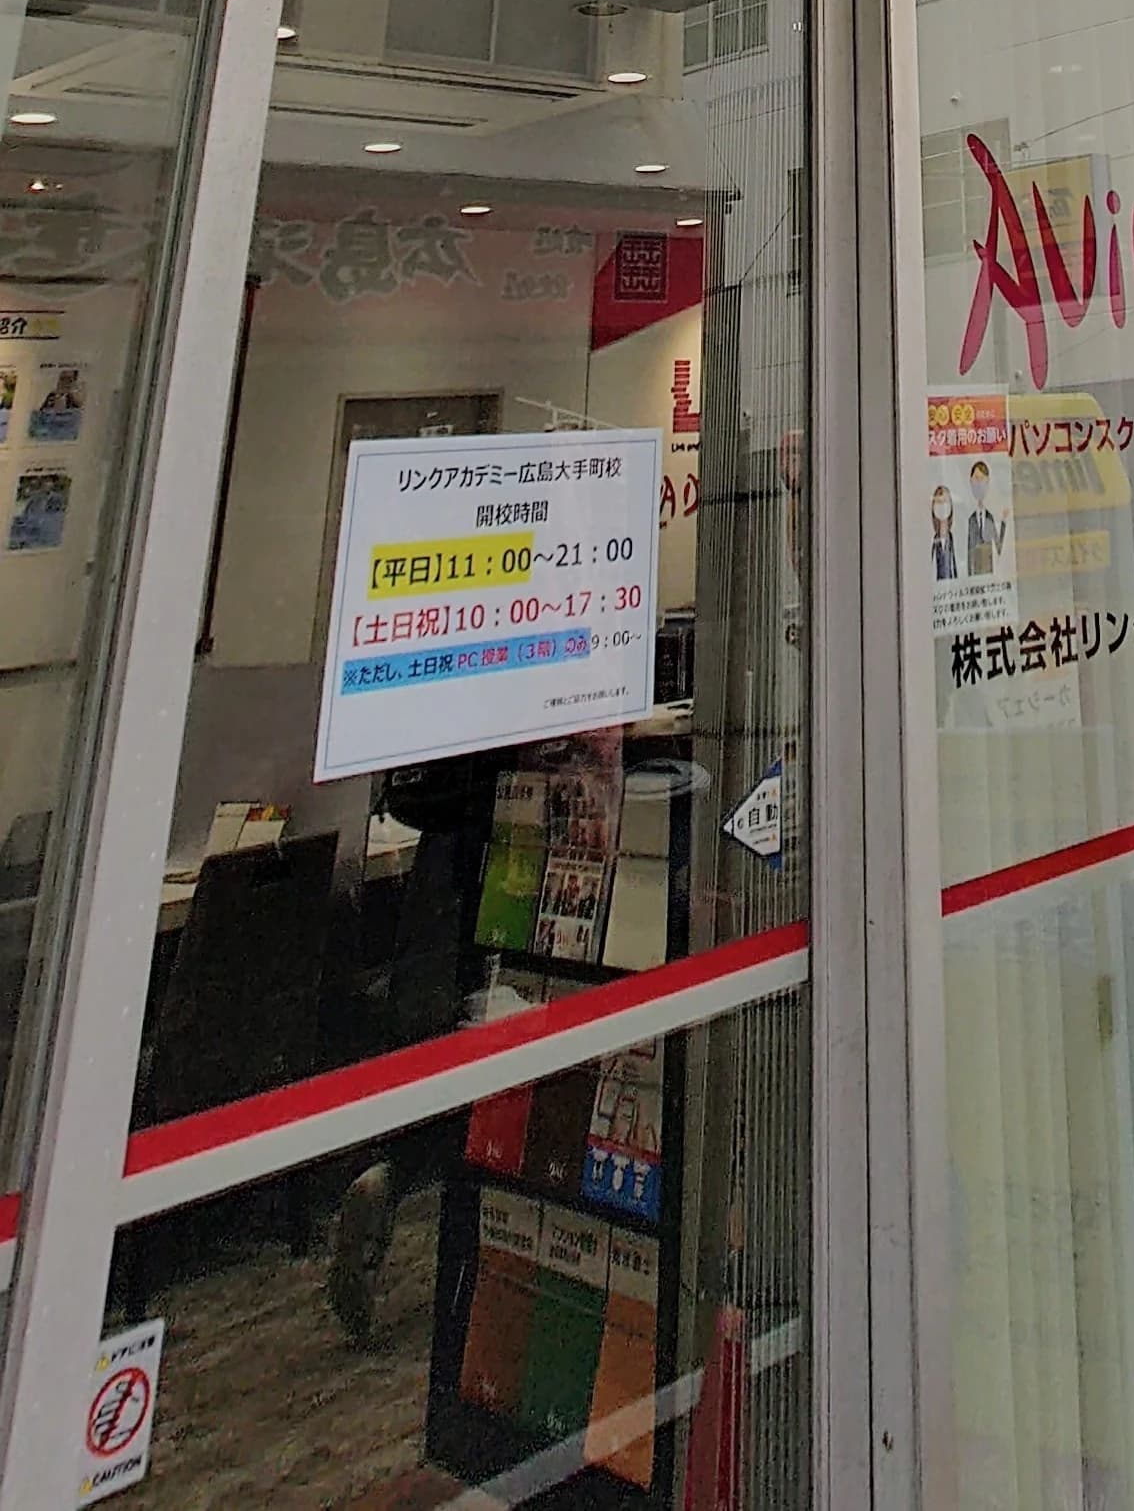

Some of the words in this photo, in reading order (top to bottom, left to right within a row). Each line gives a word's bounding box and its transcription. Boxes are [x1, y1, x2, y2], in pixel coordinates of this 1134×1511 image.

[398, 457, 622, 492] リンクアカデミー広島大手町校
[476, 501, 548, 528] 開校時間
[458, 654, 478, 670] PC
[92, 1455, 143, 1487] CAUTION
